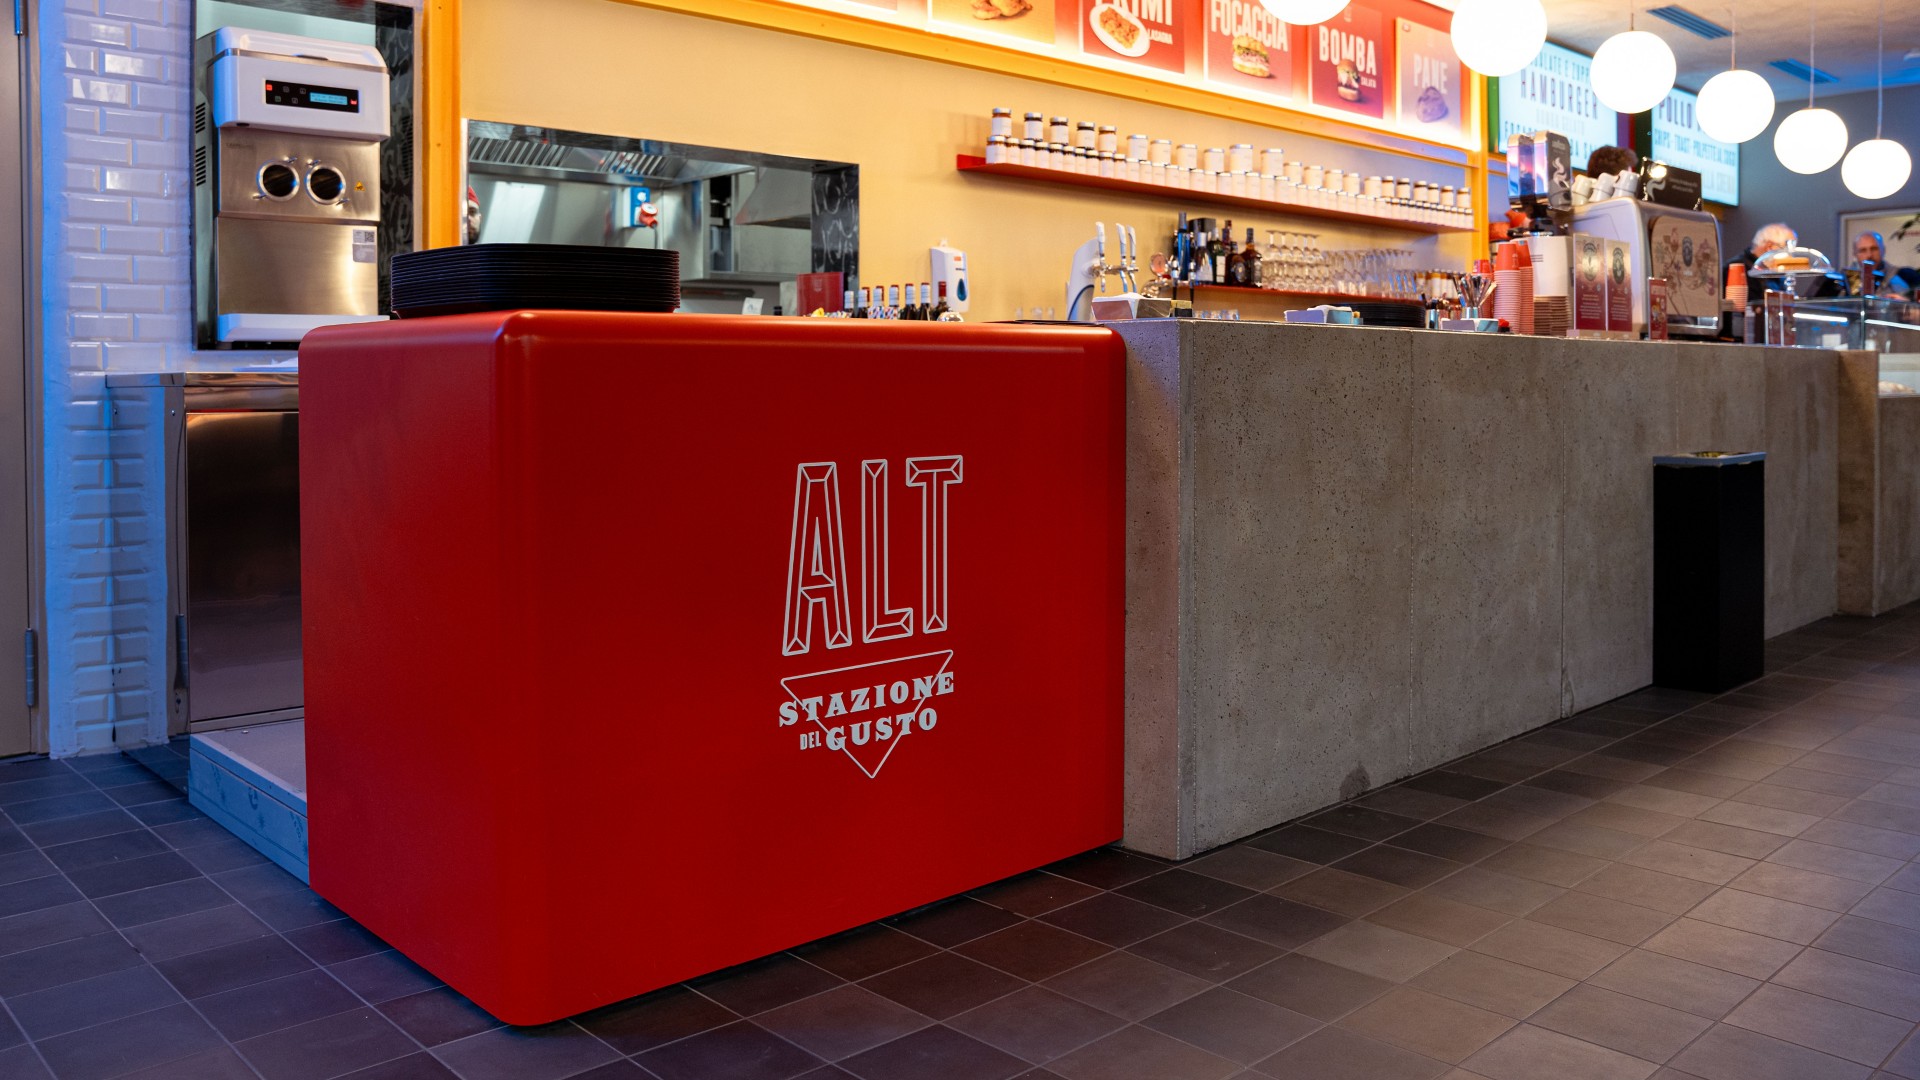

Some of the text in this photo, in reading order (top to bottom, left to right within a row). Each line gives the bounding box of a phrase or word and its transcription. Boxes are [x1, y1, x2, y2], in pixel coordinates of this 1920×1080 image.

[1095, 0, 1172, 26] IMI
[1211, 0, 1288, 52] FOCACCIA
[1319, 25, 1377, 76] BOMBA
[1413, 54, 1448, 95] PANE
[1520, 68, 1598, 120] HAMBURGER
[1659, 95, 1692, 130] POLLO
[782, 455, 963, 656] ALT
[779, 671, 955, 727] STAZIONE
[800, 708, 937, 750] DEL GUSTO
